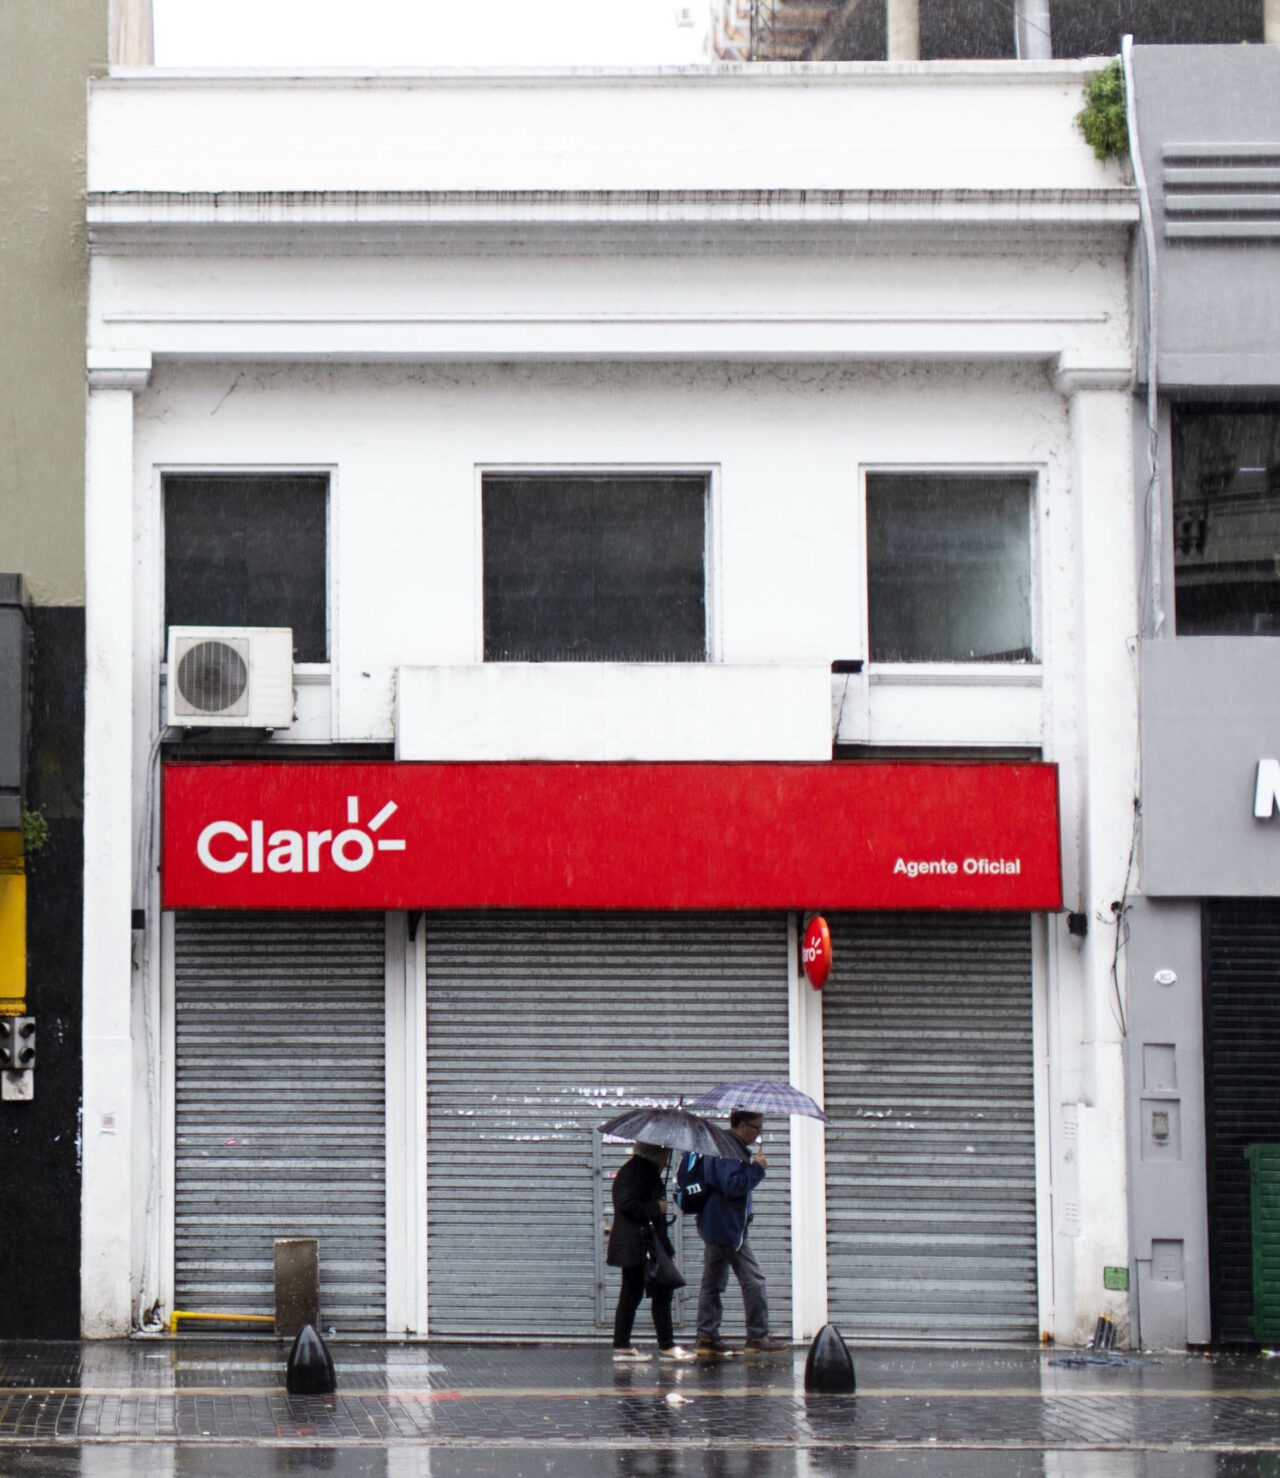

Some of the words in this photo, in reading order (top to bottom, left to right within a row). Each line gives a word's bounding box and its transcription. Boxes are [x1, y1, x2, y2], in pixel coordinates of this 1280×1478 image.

[197, 820, 373, 873] Claro
[893, 858, 958, 878] Agente
[962, 858, 1021, 875] Oficial
